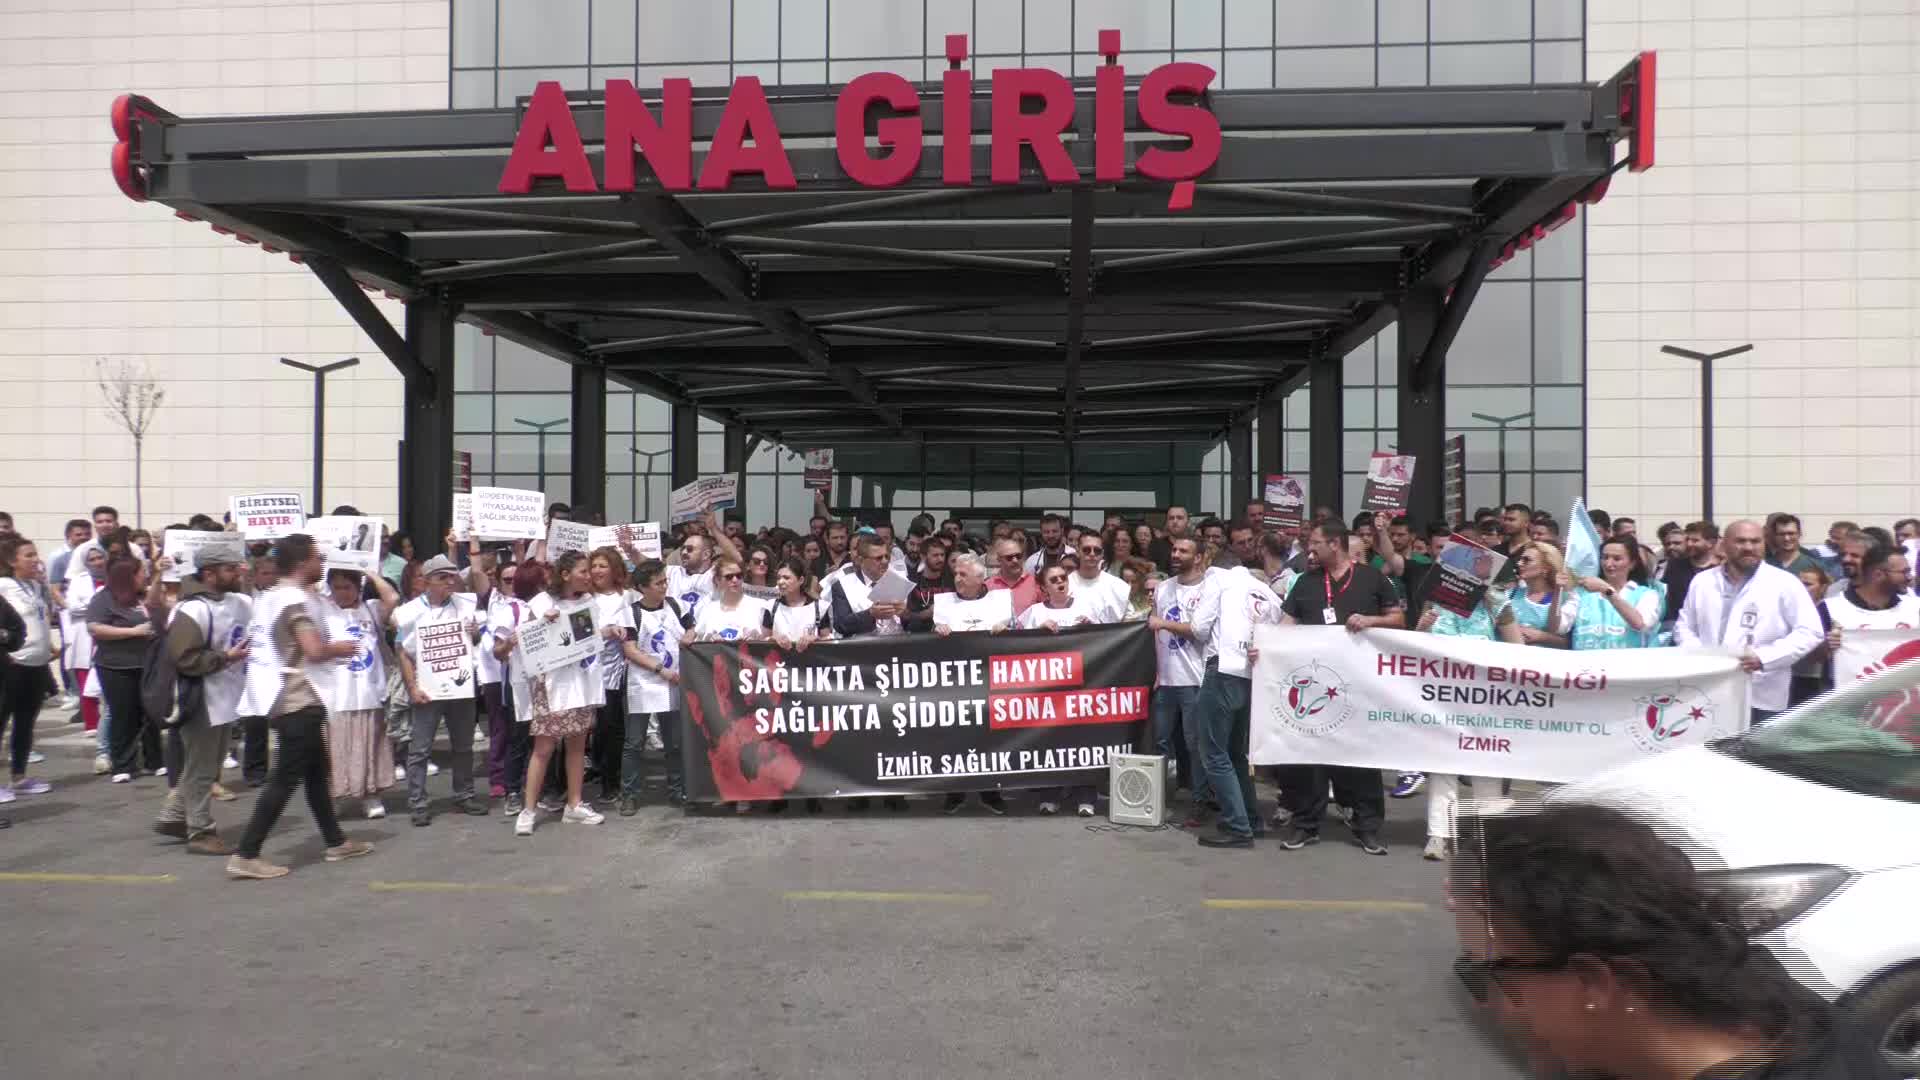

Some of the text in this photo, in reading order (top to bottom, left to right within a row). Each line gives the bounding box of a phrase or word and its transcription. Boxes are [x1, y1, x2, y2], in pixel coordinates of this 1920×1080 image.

[498, 29, 1221, 209] ANA GİRİŞ
[423, 635, 461, 648] VARSA
[739, 656, 1073, 697] SAĞLIKTA ŞİDDETE HAYIR!
[1377, 653, 1475, 681] HEKİM
[1420, 684, 1554, 708] SENDİKASI
[755, 687, 1142, 737] SAĞLIKTA ŞİDDET SONA ERSİN!
[1420, 713, 1441, 725] OL
[1539, 719, 1585, 732] UMUT
[1588, 723, 1611, 736] OL
[1458, 733, 1511, 752] İZMİR
[877, 751, 933, 777] İZMİR
[940, 748, 1012, 774] SAĞLIK
